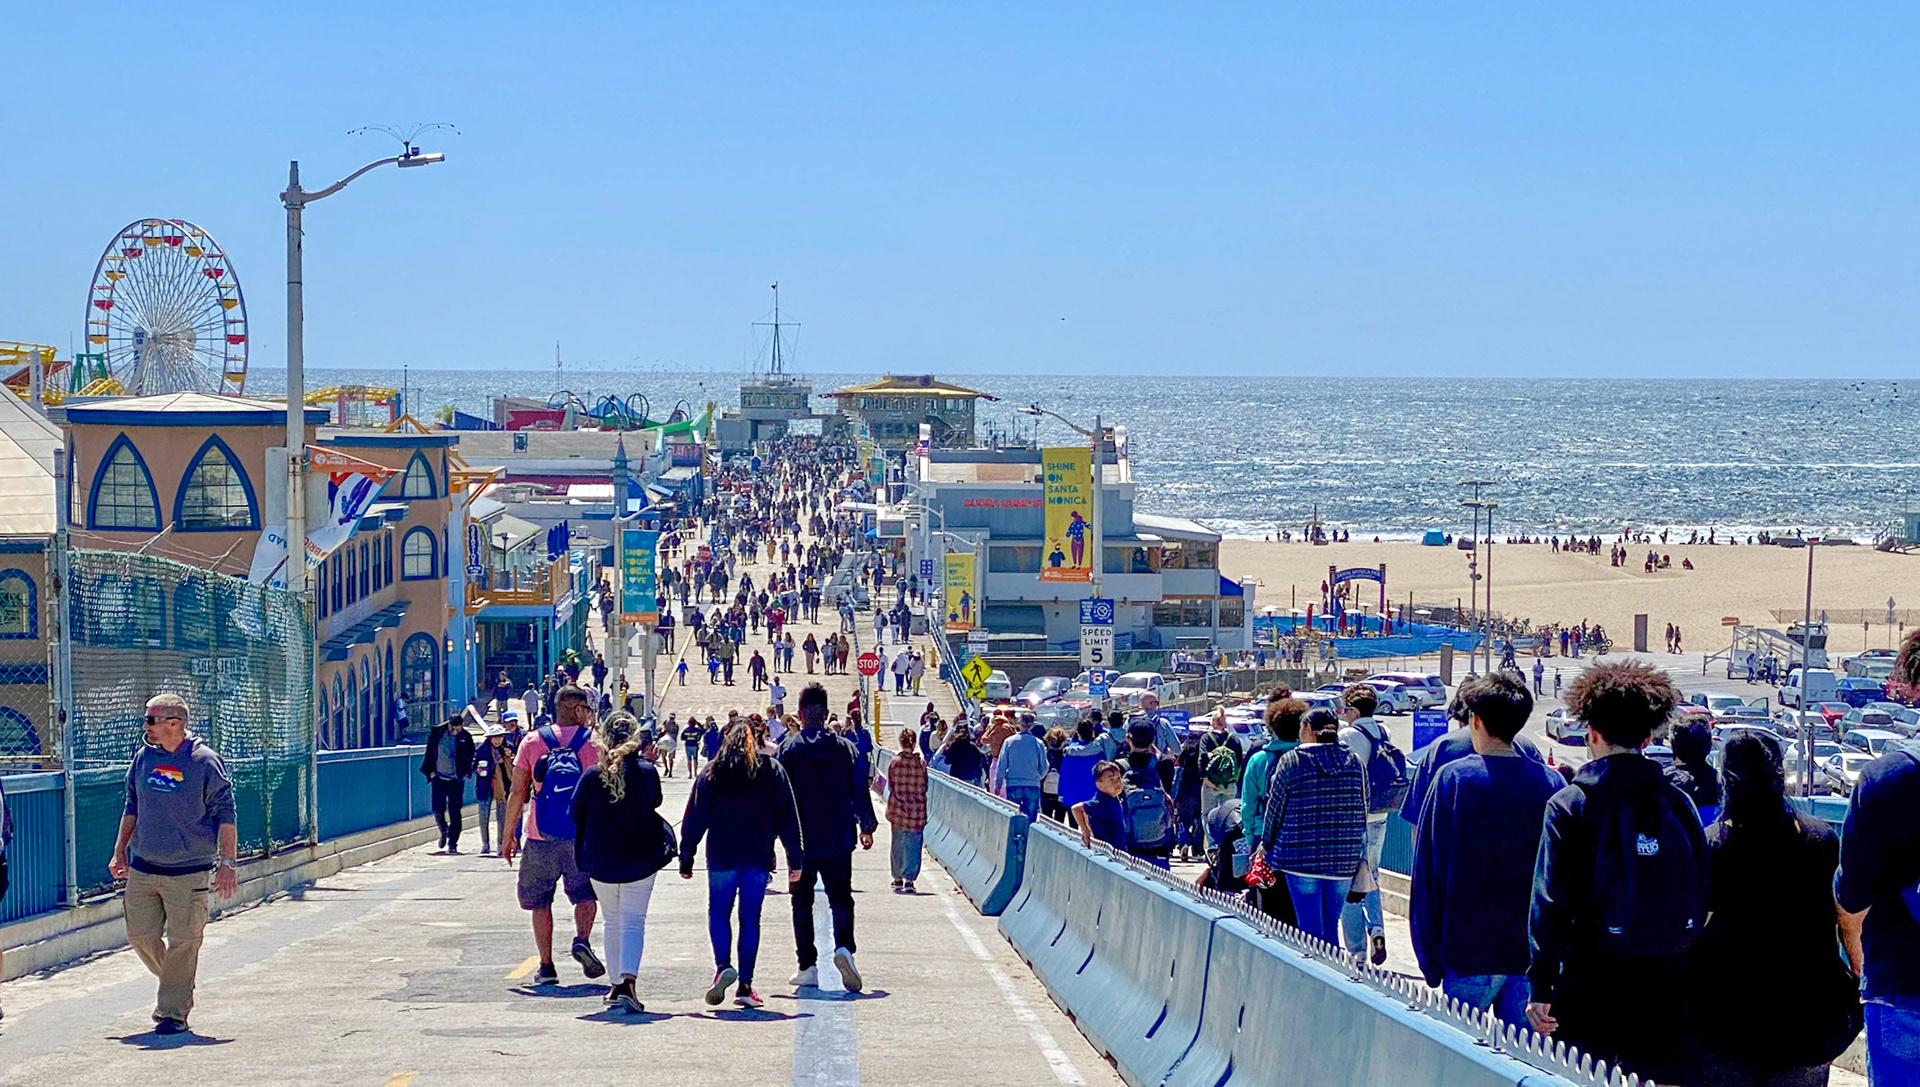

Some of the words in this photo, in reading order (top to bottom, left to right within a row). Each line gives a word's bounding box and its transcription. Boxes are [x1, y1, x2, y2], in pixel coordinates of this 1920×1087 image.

[1047, 462, 1075, 470] SHINE
[1048, 473, 1063, 482] ON
[1048, 485, 1078, 493] SANTA
[1048, 496, 1087, 505] MONICA
[1082, 628, 1112, 636] SPEED
[1091, 648, 1103, 664] 5
[858, 659, 879, 669] STOP
